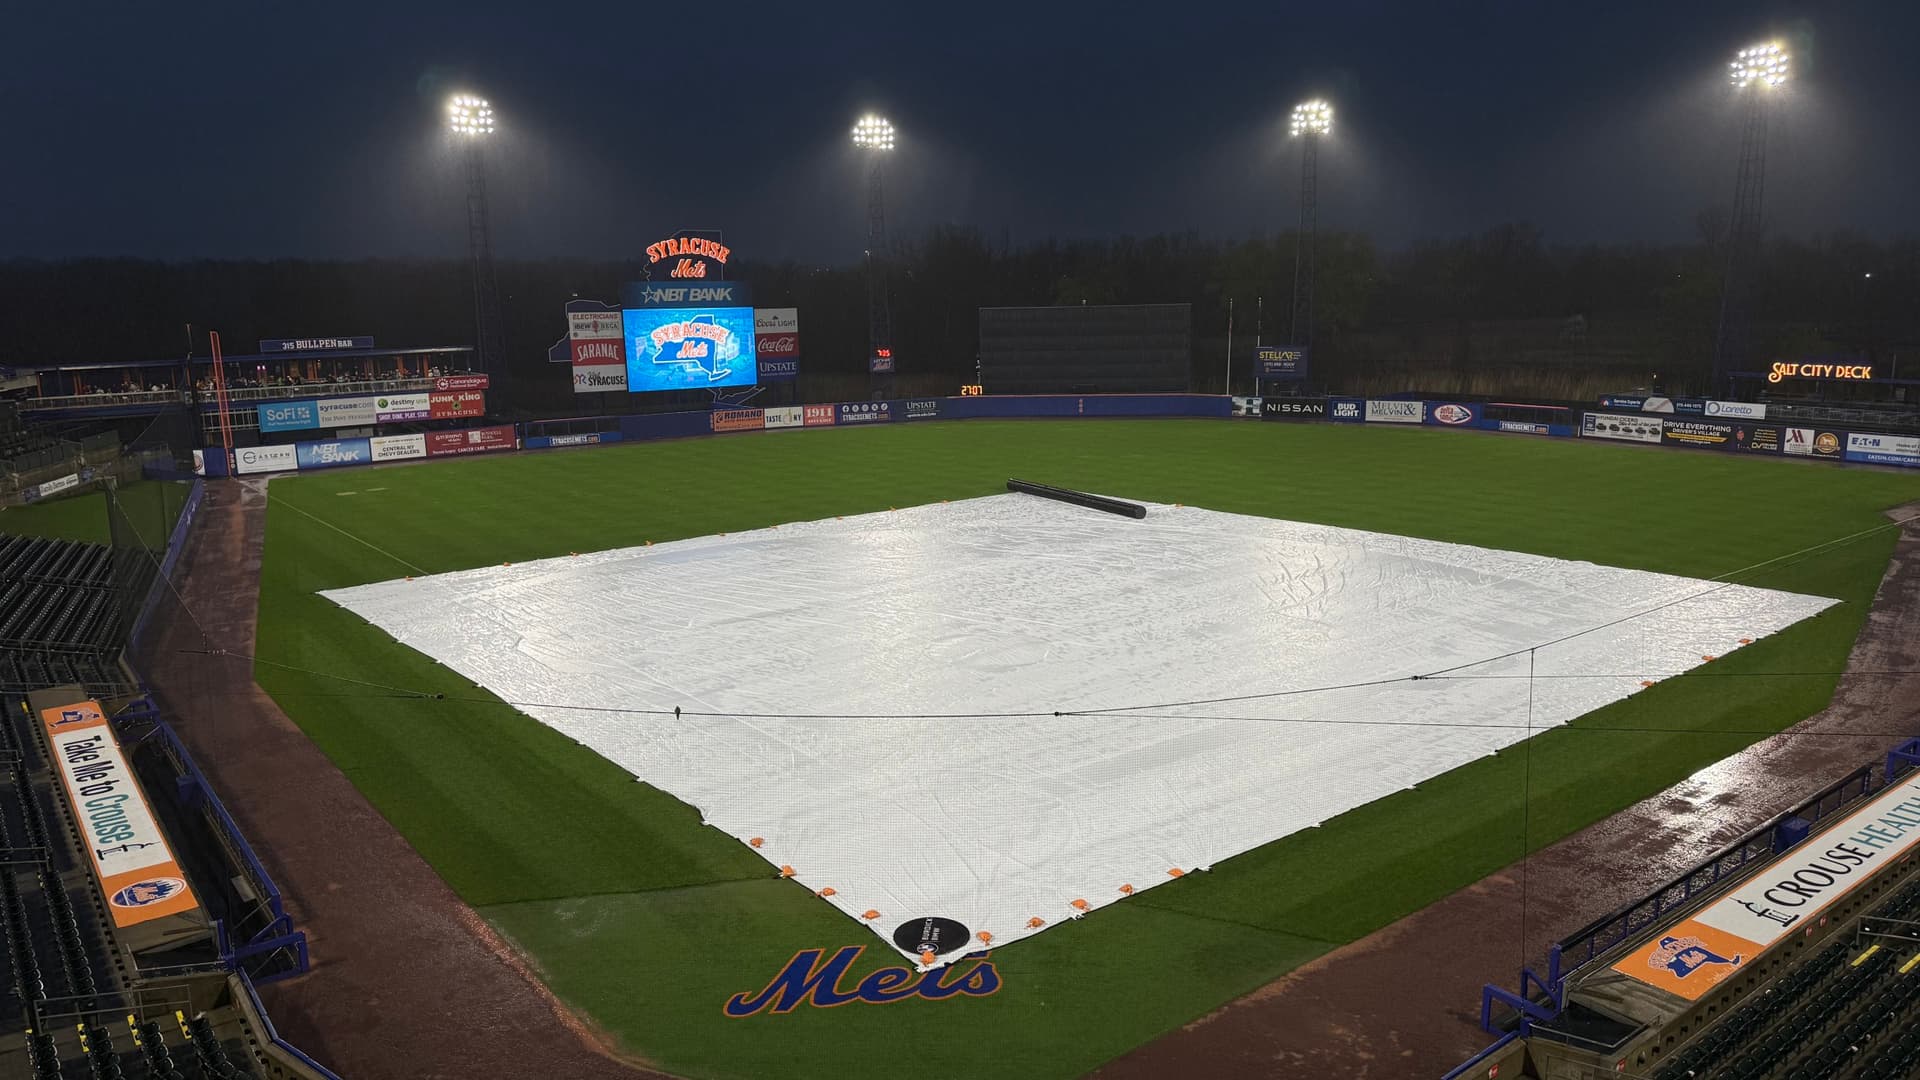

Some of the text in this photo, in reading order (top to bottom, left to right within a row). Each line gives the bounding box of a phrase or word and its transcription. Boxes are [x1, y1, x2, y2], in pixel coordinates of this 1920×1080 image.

[647, 237, 730, 263] SYRACUSE
[670, 258, 706, 278] Mets
[656, 287, 733, 301] NBT BANK
[652, 323, 729, 345] SYRACUSE
[282, 339, 353, 350] 315 BULLPEN BAR
[677, 341, 708, 358] Mets
[577, 343, 619, 362] SARANAC
[1259, 351, 1294, 360] STELLAR
[760, 361, 797, 372] UPSTATE
[1768, 361, 1872, 383] SALT CITY DECK
[588, 375, 624, 386] SYRACUSE
[430, 394, 454, 403] JUNK
[906, 401, 936, 409] UPSTATE
[1267, 403, 1323, 413] NISSAN
[1721, 405, 1752, 414] Loretto
[266, 408, 295, 421] SoFi
[436, 409, 479, 417] SYRACUSE
[807, 408, 832, 417] 1911
[1333, 409, 1360, 417] LIGHT
[766, 415, 782, 423] TASTE
[1686, 423, 1732, 433] EVERYTHING
[312, 443, 341, 455] NBT
[382, 445, 406, 453] CENTRAL
[320, 451, 359, 463] BANK
[62, 735, 105, 764] Take
[71, 760, 114, 783] Me
[79, 779, 120, 797] to
[85, 794, 135, 844] Crouse
[1763, 842, 1875, 908] CROUSE
[723, 945, 1003, 1017] Mets
